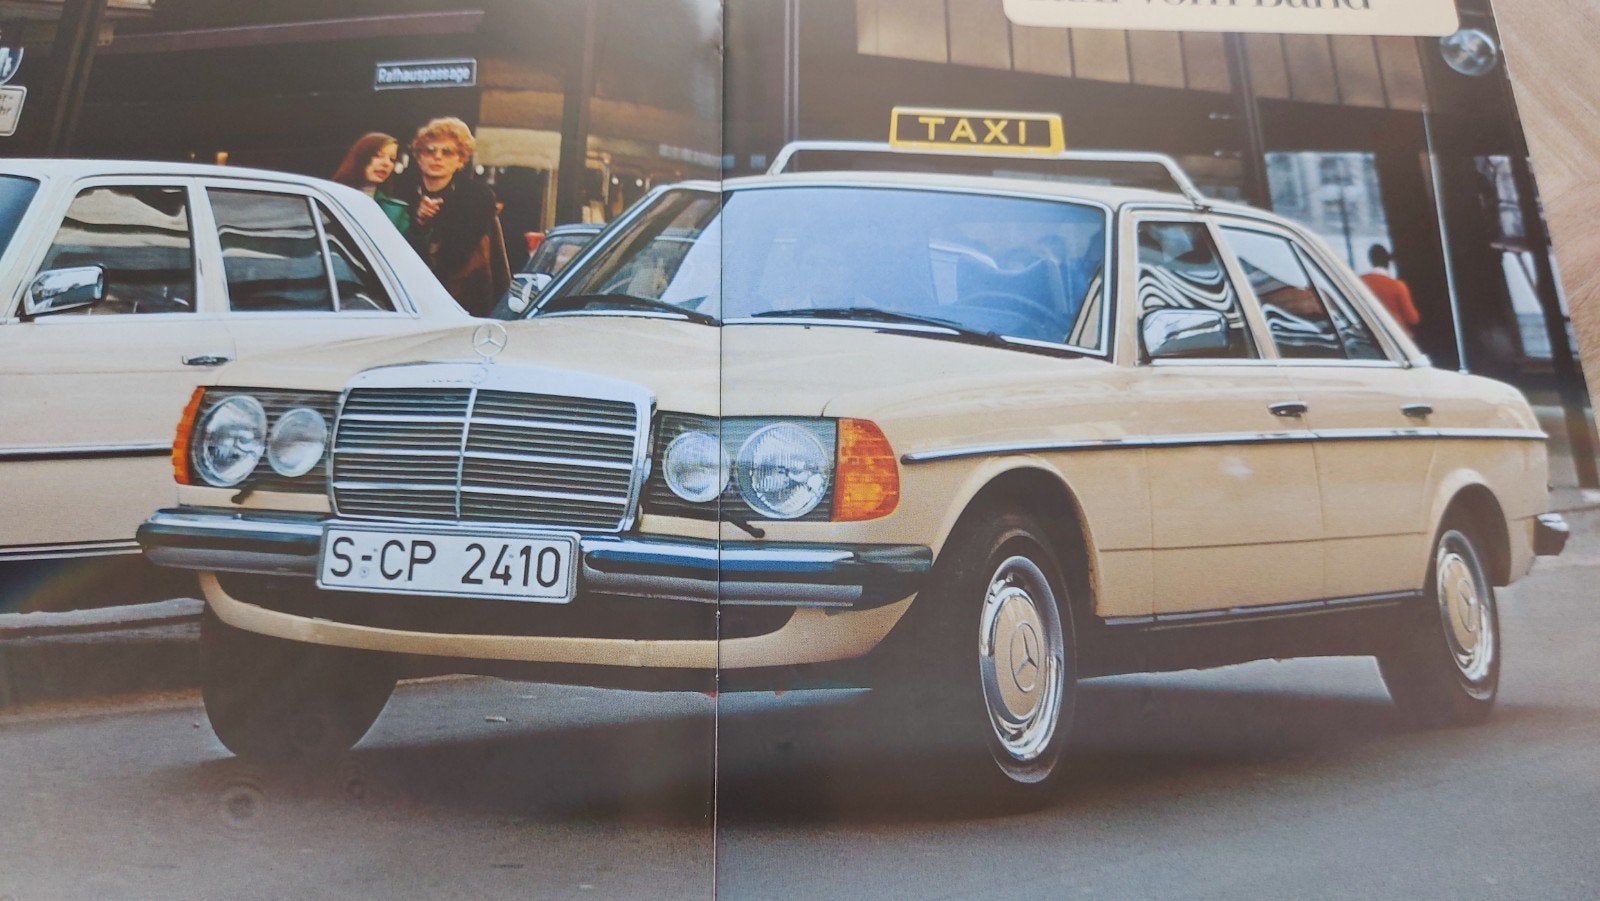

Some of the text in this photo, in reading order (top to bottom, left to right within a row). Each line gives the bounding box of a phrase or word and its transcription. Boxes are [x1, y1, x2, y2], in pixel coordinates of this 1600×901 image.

[918, 116, 1026, 145] TAXI
[330, 536, 561, 588] S-CP 2410
